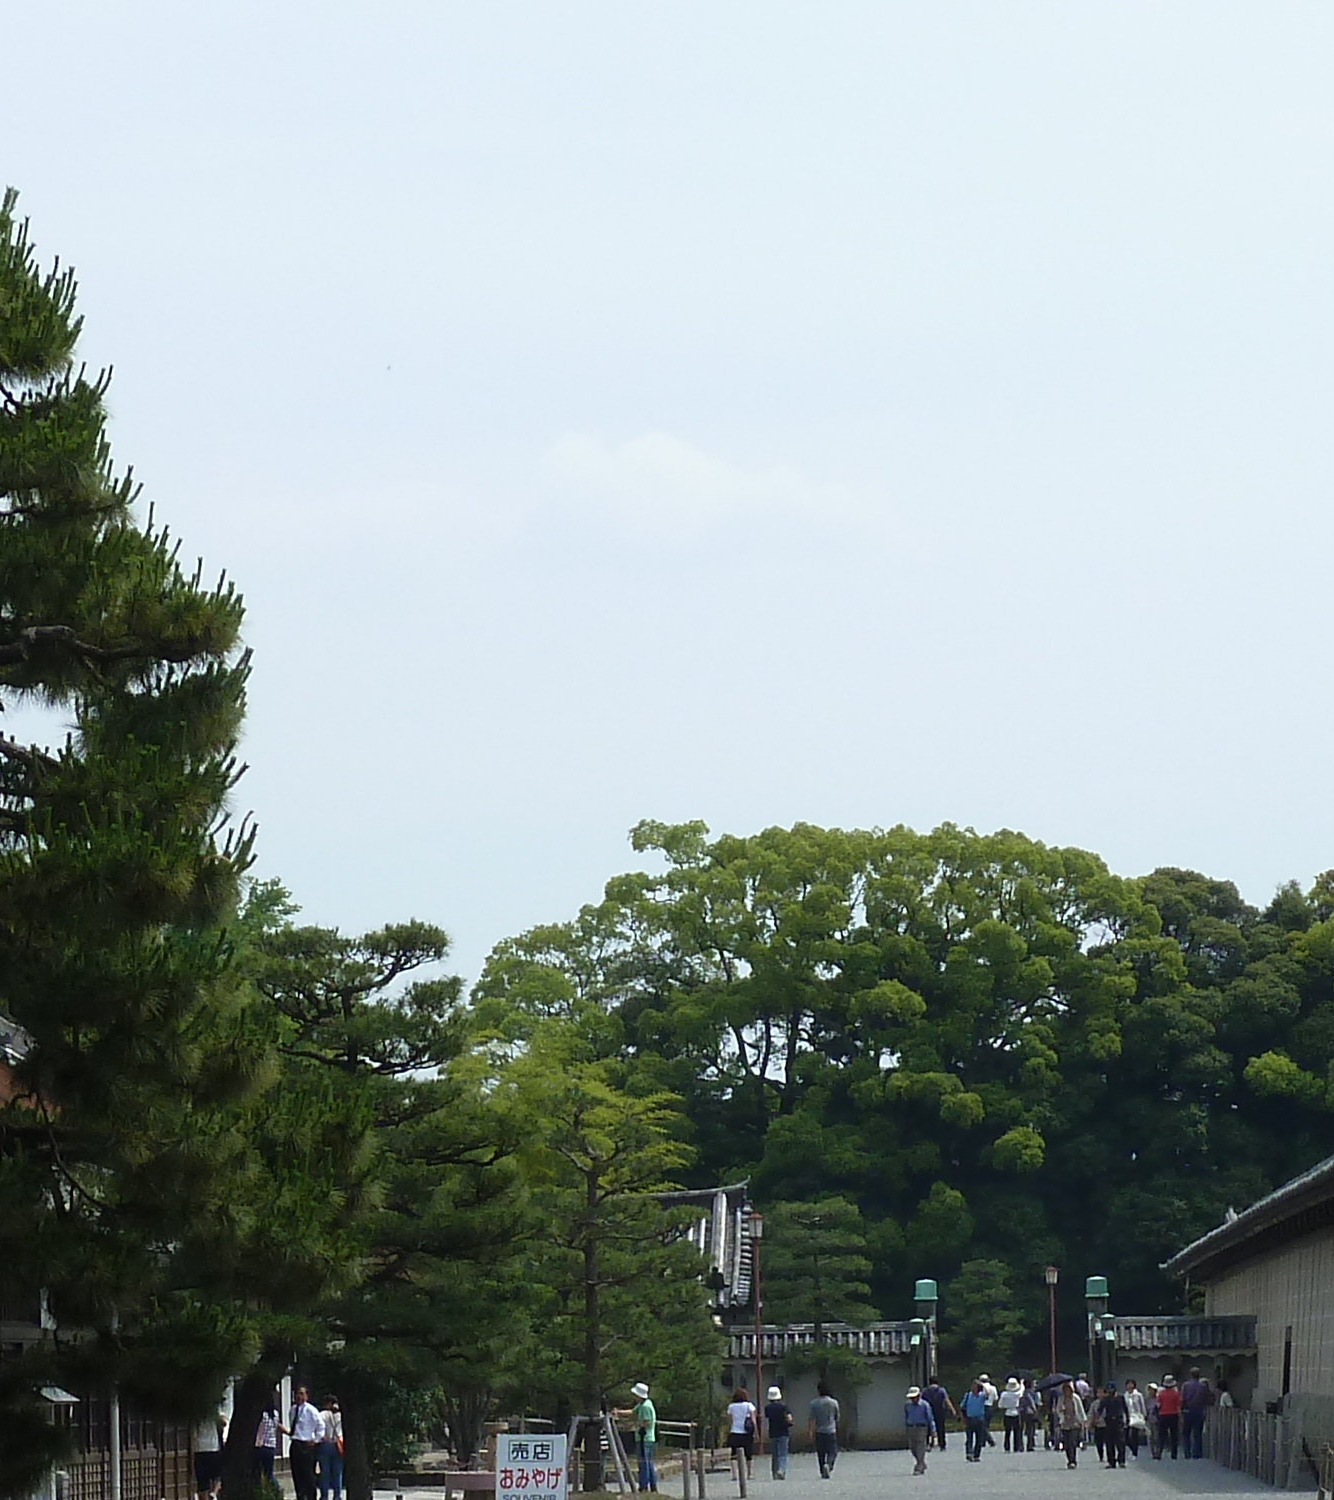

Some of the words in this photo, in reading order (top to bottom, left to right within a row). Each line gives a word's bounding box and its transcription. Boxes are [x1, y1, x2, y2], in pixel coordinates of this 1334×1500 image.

[511, 1443, 550, 1460] 売店
[500, 1467, 562, 1489] おみやげ
